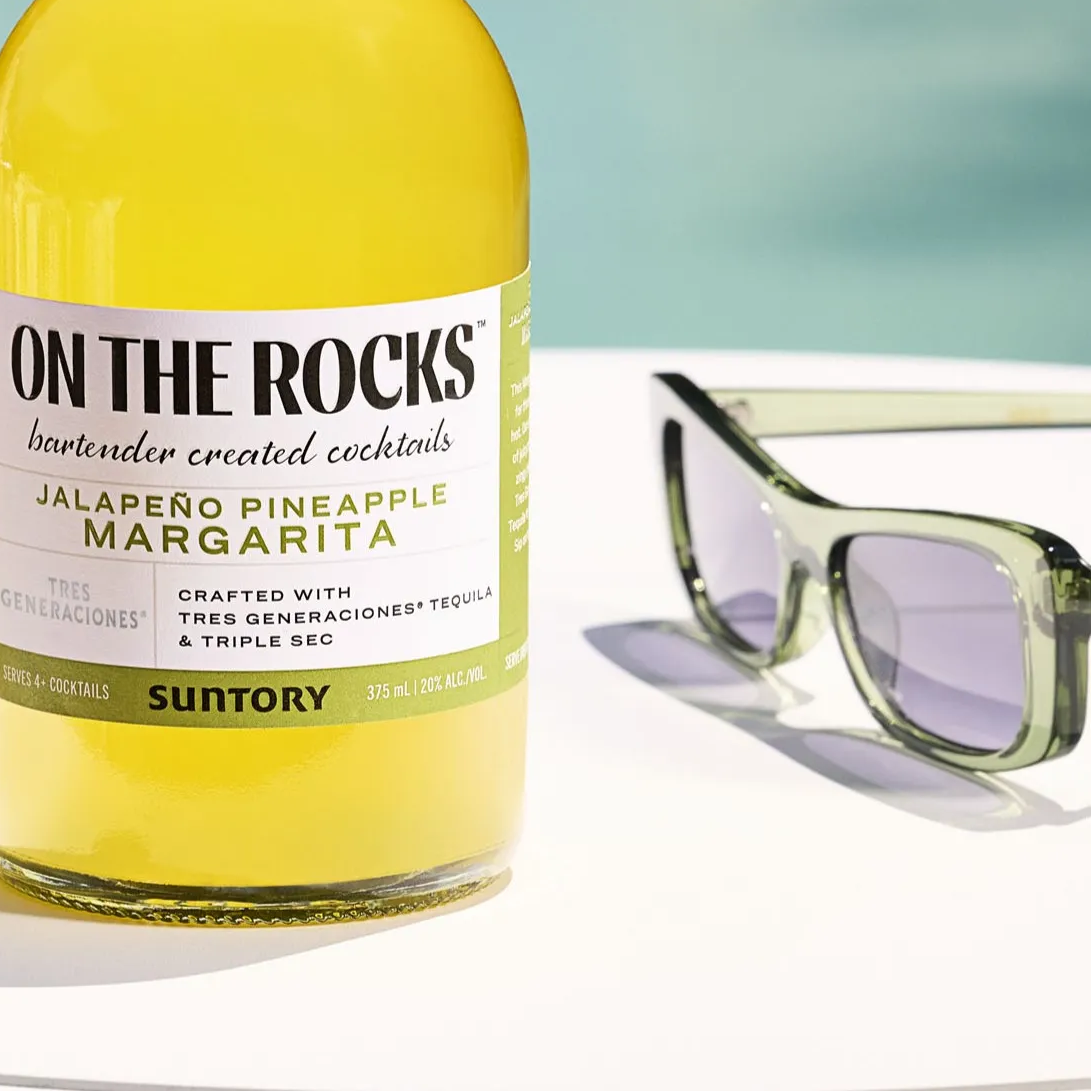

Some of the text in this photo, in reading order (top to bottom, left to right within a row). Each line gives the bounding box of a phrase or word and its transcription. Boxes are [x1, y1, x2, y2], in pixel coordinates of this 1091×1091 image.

[11, 324, 86, 409] ON
[98, 335, 233, 416] THE
[27, 417, 456, 467] bartender created cocktails
[35, 482, 447, 520] JALAPEÑO PINEAPPLE
[83, 517, 397, 555] MARGARITA
[48, 576, 91, 602] TRES
[178, 586, 351, 603] CRAFTED WITH
[178, 611, 237, 625] TRES
[429, 585, 493, 611] TEQUILA
[178, 632, 334, 649] & TRIPLE SEC
[3, 664, 110, 701] SERVES 4+ COCKTAILS
[148, 684, 332, 714] SUNTORY
[366, 664, 488, 701] 375 mL 20% ALC./VOL.
